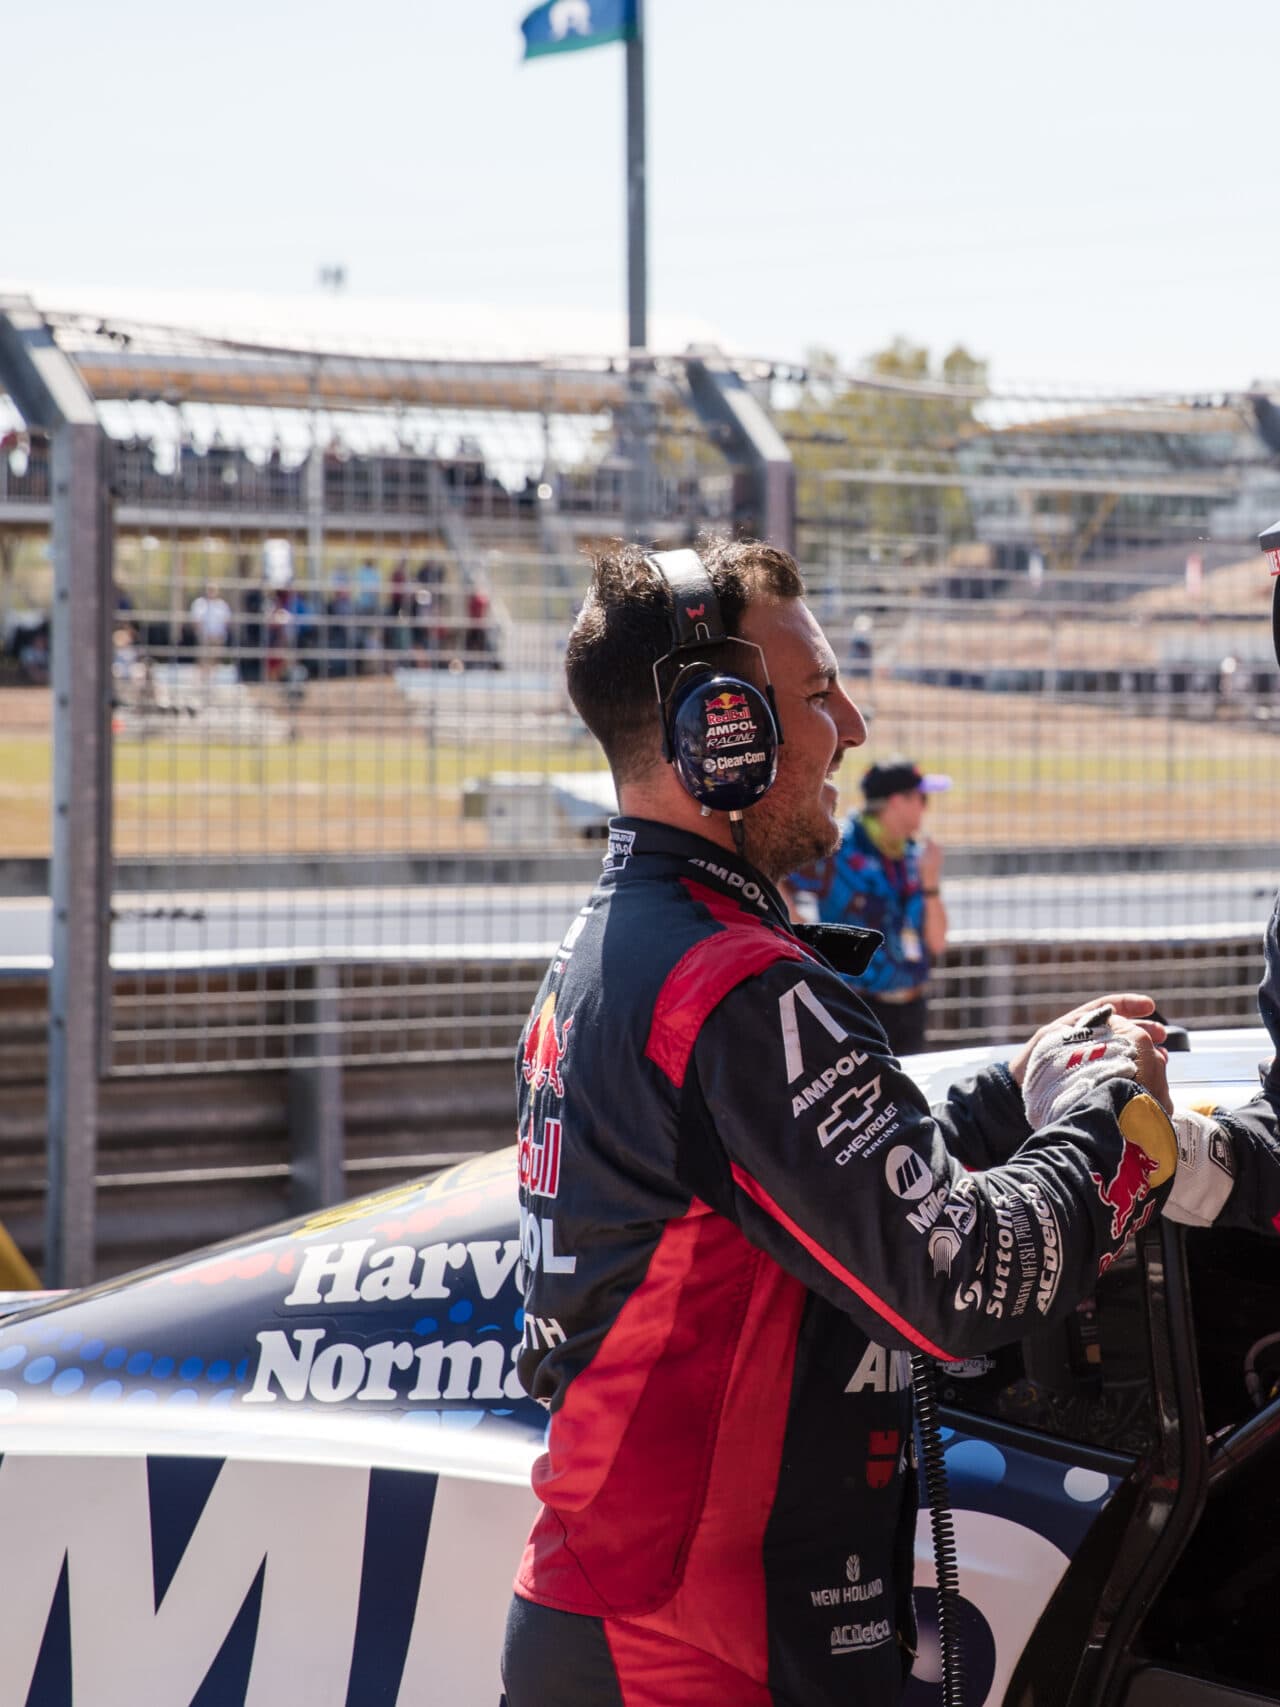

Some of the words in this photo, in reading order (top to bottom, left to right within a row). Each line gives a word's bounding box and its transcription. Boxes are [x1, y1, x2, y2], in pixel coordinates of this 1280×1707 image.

[706, 720, 757, 738] AMPOL
[707, 709, 728, 725] Red
[730, 706, 751, 721] Bull
[706, 732, 755, 748] RACING
[717, 752, 765, 770] Clear-Com
[688, 858, 769, 911] AMPOL
[791, 1050, 869, 1119] AMPOL
[835, 1102, 899, 1166] CHEVROLET
[862, 1122, 900, 1159] RACING
[285, 1236, 526, 1306] Harv
[811, 1588, 840, 1607] NEW
[844, 1578, 883, 1602] HOLLAND
